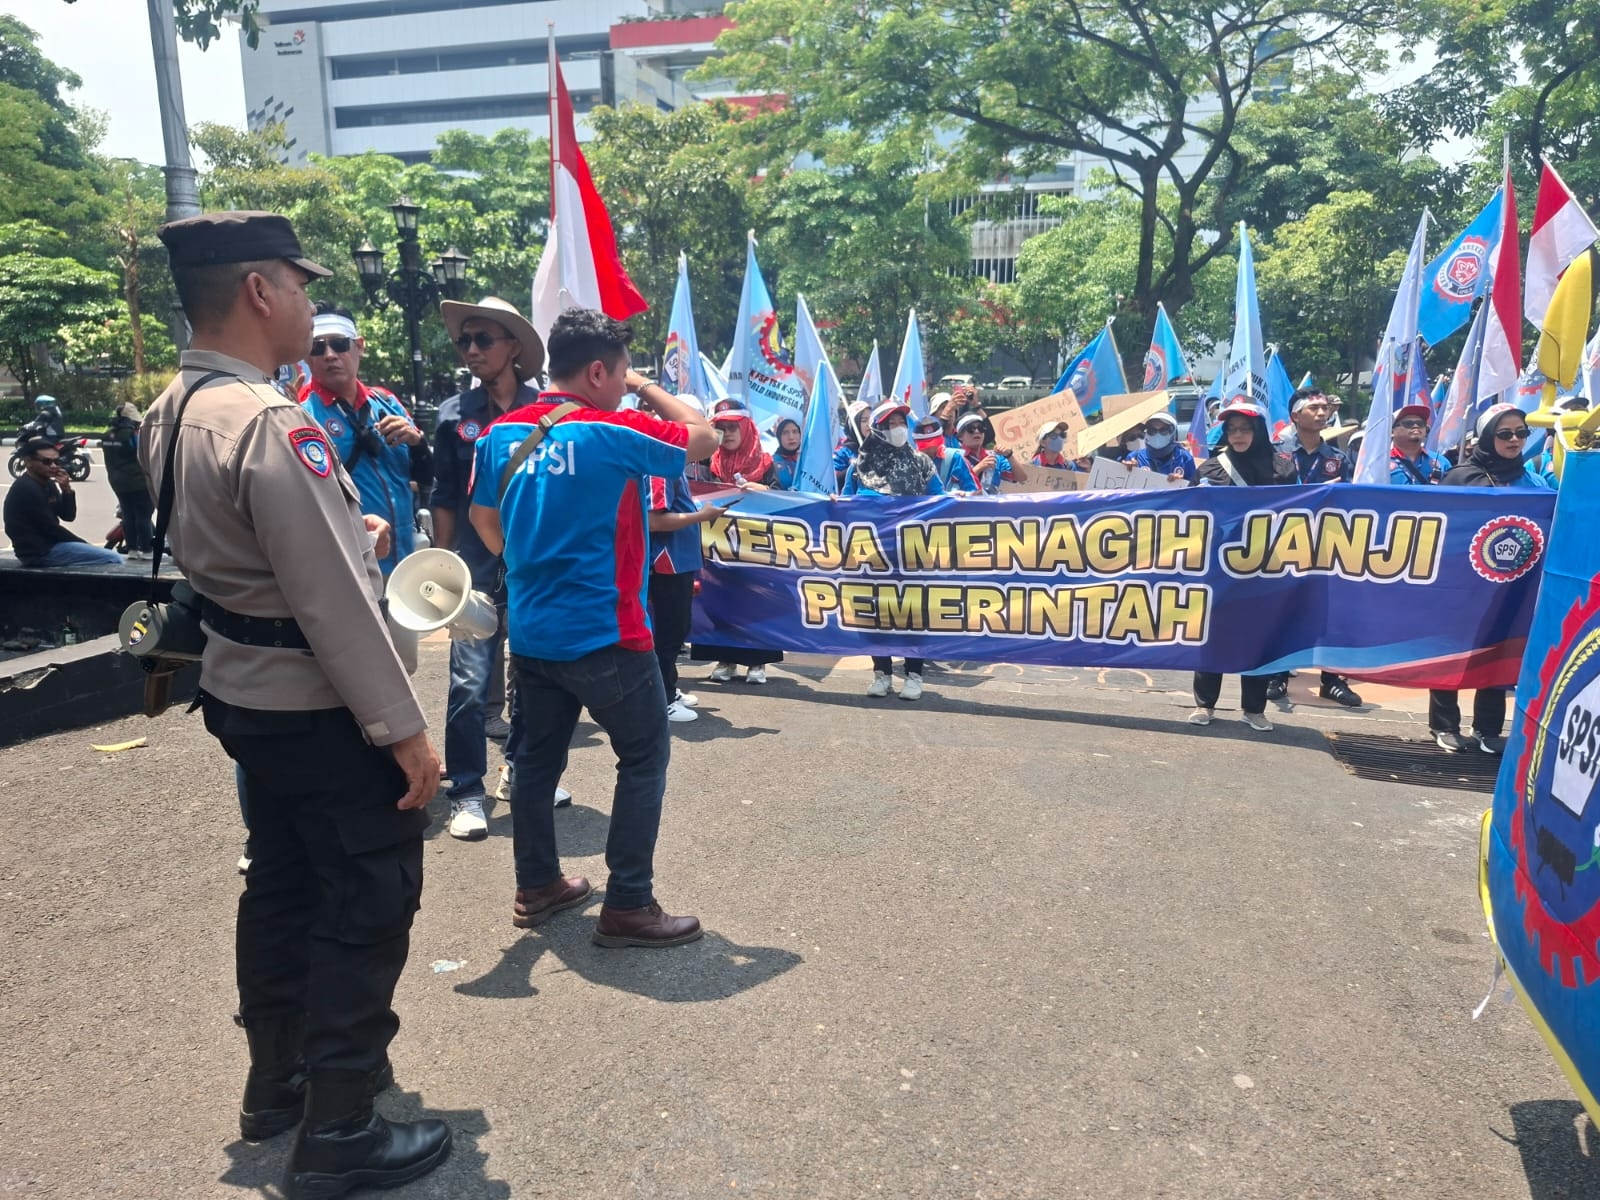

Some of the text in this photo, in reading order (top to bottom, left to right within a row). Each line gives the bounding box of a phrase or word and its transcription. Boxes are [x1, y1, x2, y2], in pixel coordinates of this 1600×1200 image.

[701, 511, 1446, 582] KERJA MENAGIH JANJI
[1496, 543, 1518, 556] SPSI
[799, 578, 1211, 644] PEMERINTAH
